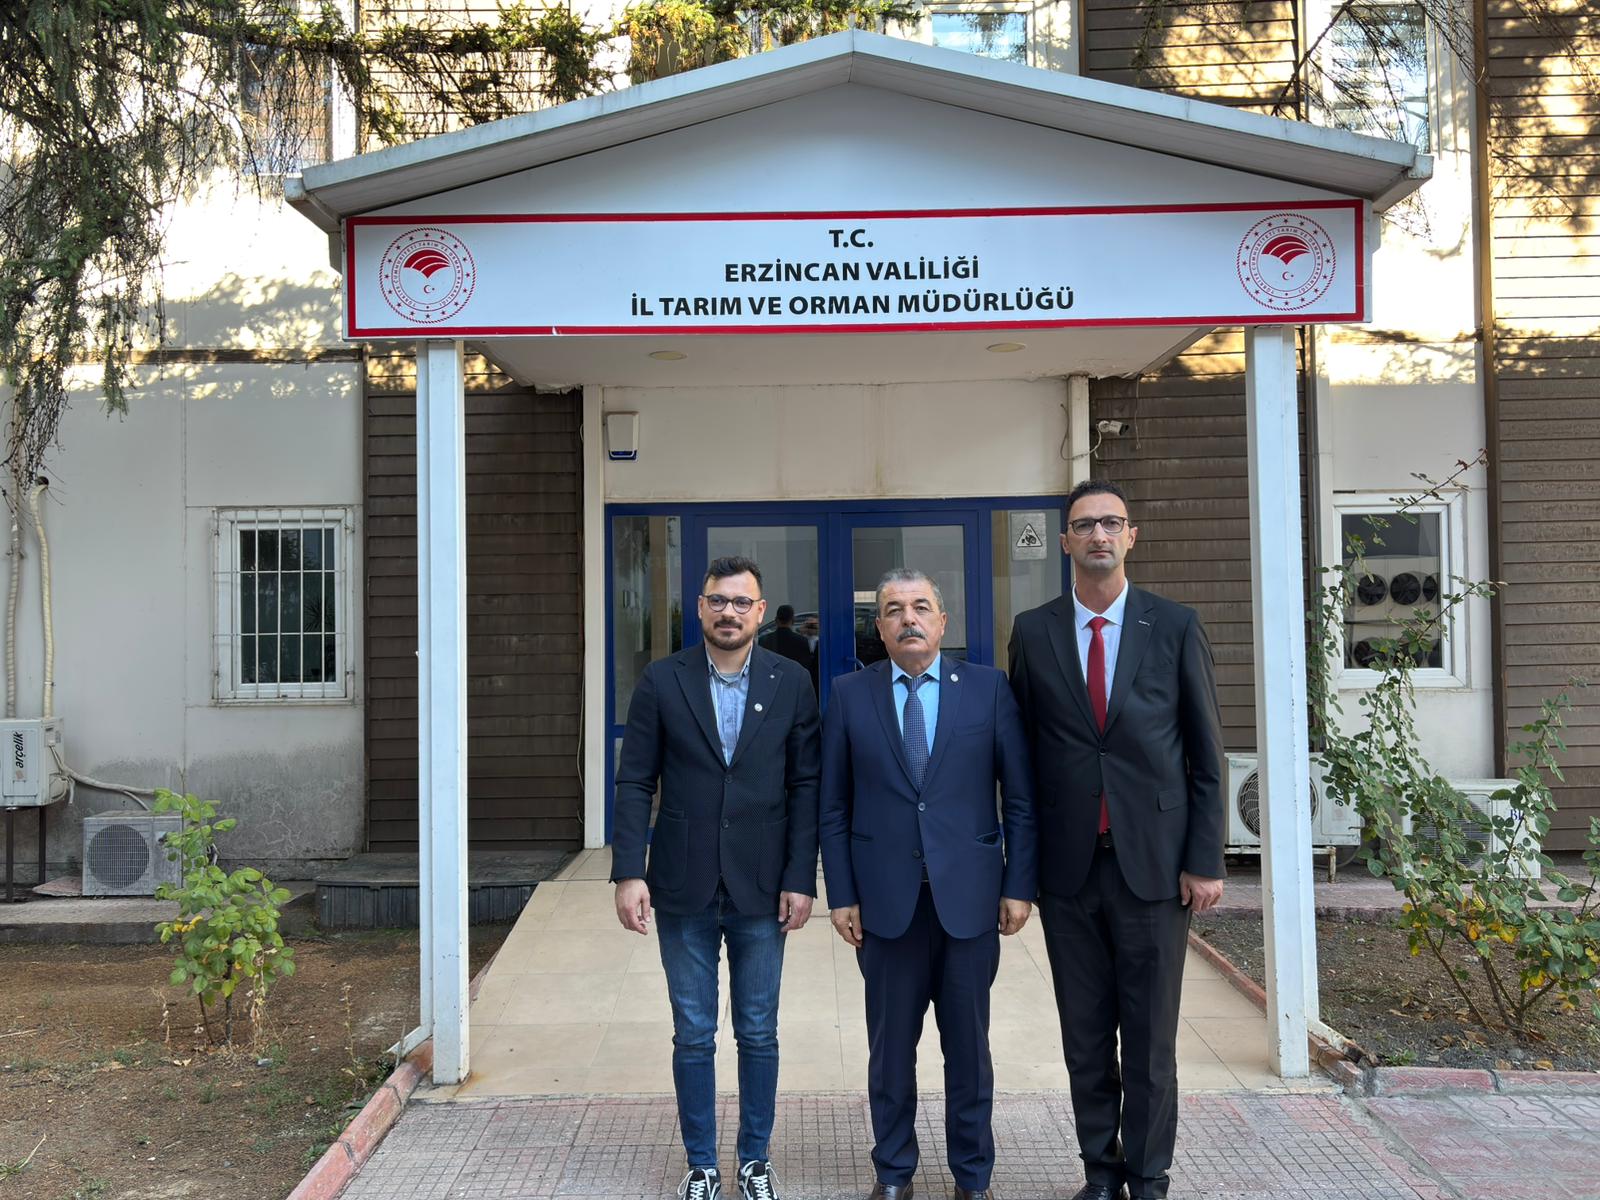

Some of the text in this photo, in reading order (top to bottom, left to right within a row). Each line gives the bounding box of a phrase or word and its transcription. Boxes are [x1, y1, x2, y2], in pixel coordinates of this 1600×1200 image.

[829, 228, 874, 248] T.C.
[725, 255, 979, 282] ERZİNCAN VALİLİĞİ
[631, 287, 1074, 316] İL TARIM VE ORMAN MÜDÜRLÜĞÜ
[13, 731, 26, 768] arçelik
